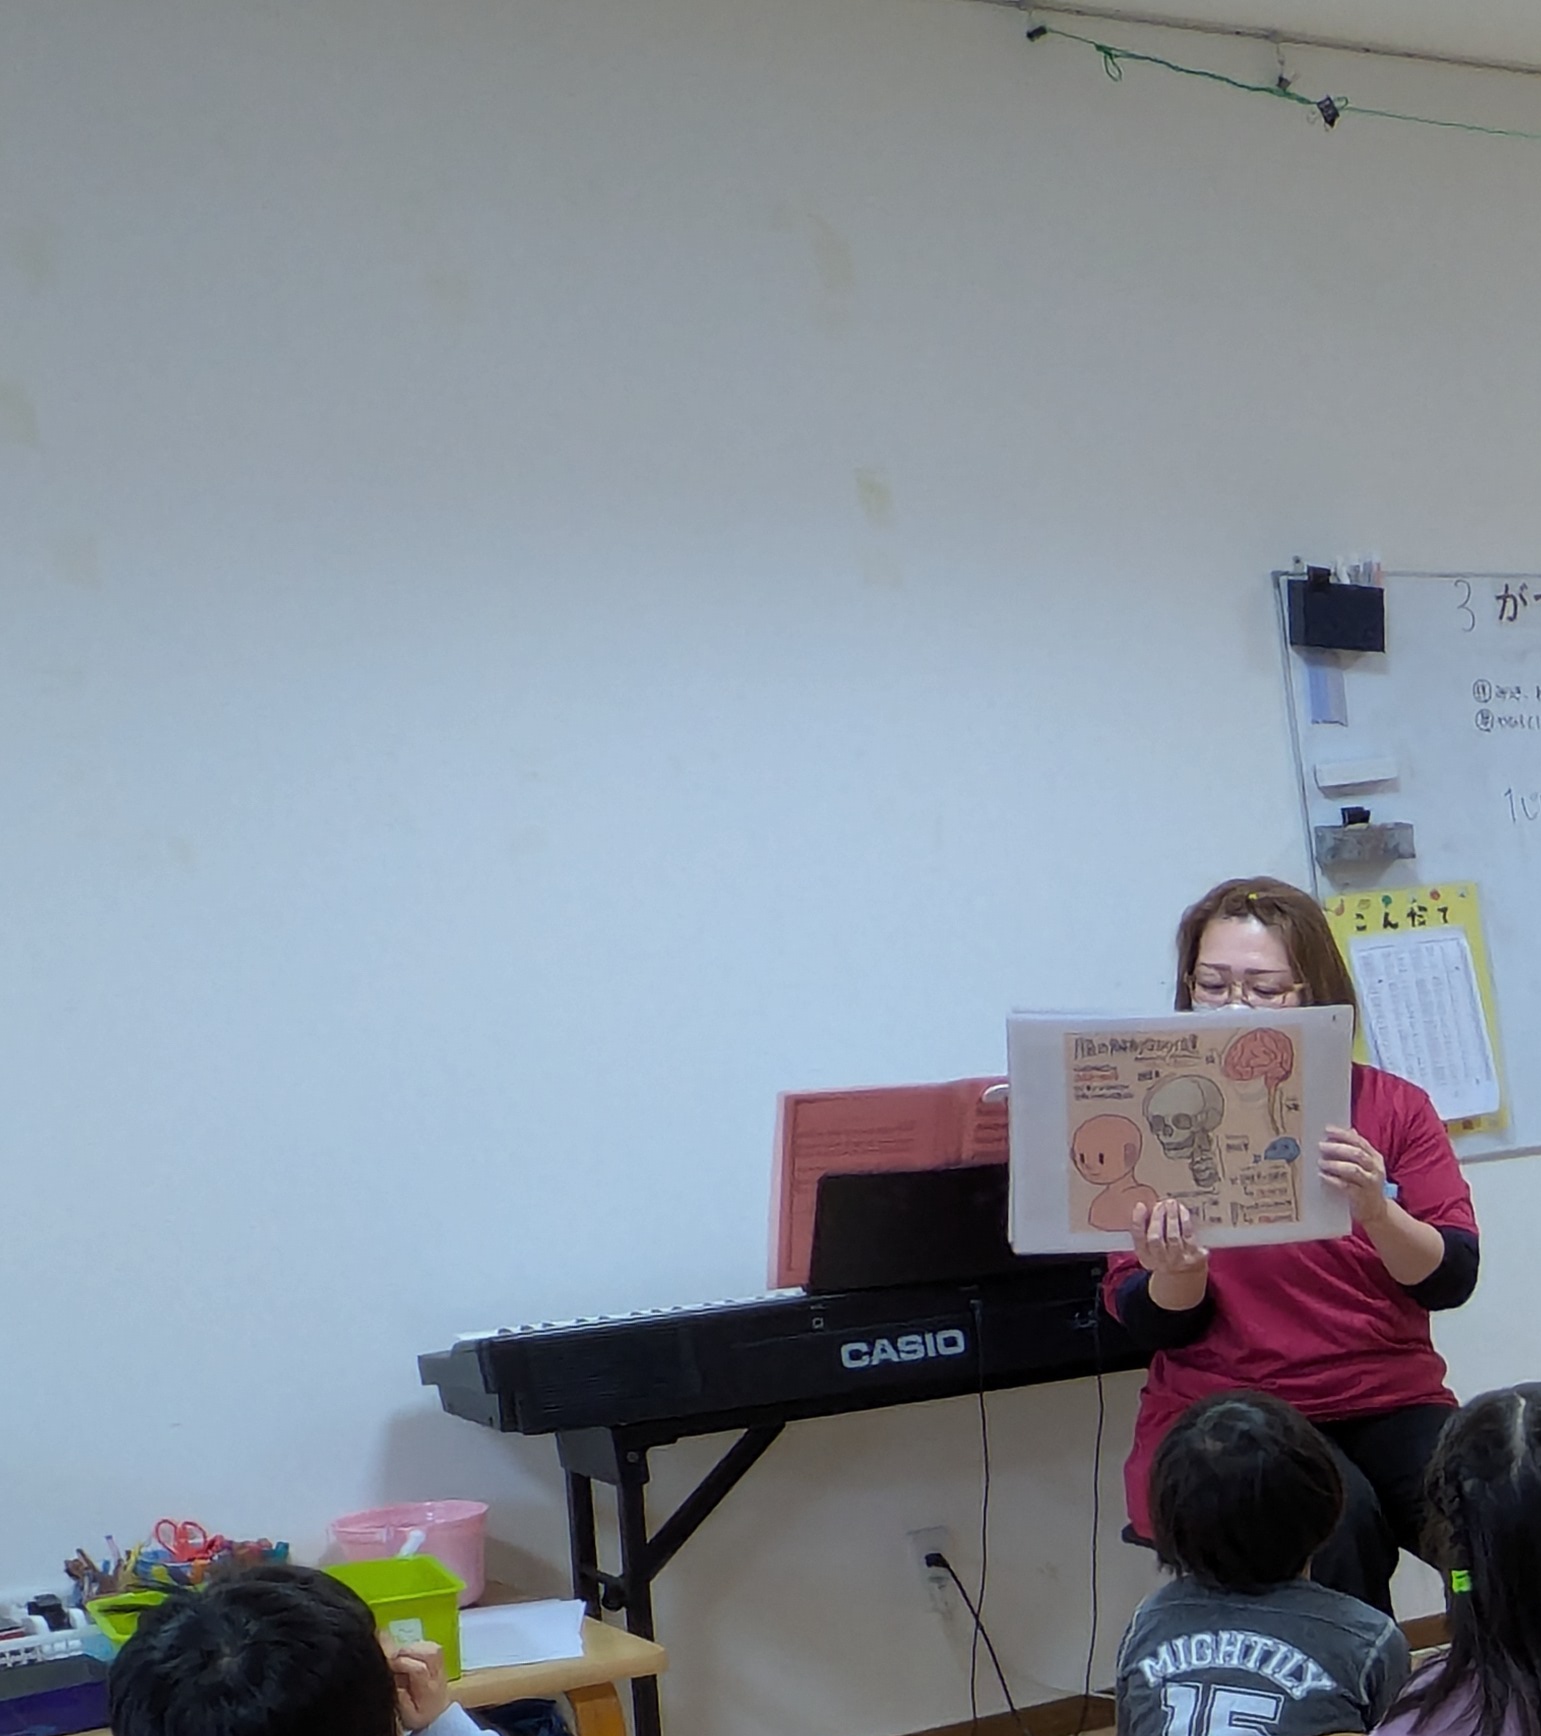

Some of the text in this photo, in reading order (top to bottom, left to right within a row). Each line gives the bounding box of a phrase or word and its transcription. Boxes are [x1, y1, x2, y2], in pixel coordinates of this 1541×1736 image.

[1454, 579, 1476, 632] 3
[1354, 904, 1450, 932] こんだて
[838, 1327, 967, 1371] CASIO
[1138, 1629, 1338, 1700] MIGHTILY
